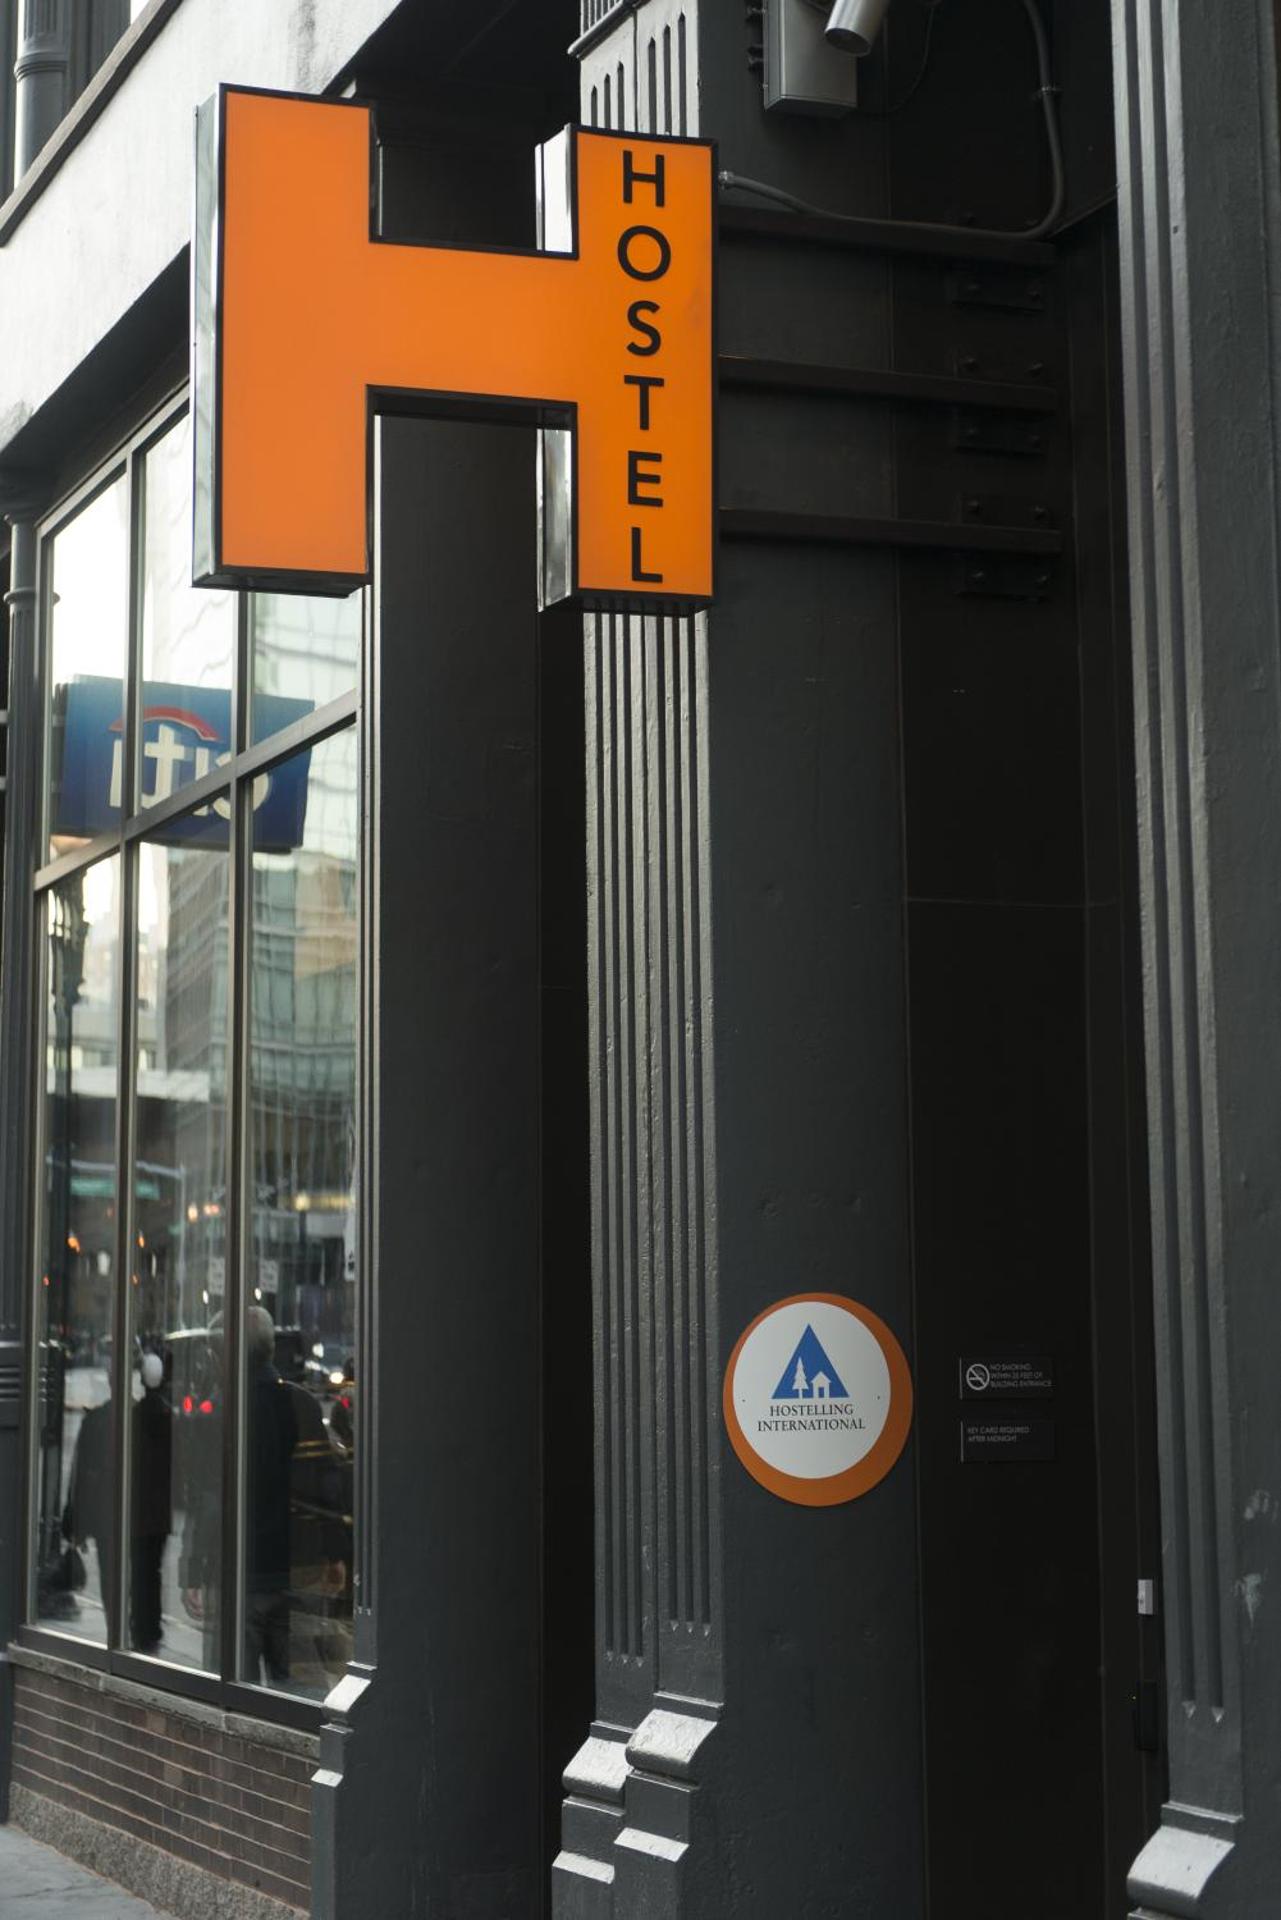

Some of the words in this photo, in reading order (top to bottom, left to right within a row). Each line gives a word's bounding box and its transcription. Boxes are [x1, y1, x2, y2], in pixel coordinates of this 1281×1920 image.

[617, 150, 672, 584] HOSTEL
[769, 1403, 854, 1417] HOSTELLING
[757, 1418, 866, 1432] INTERNATIONAL
